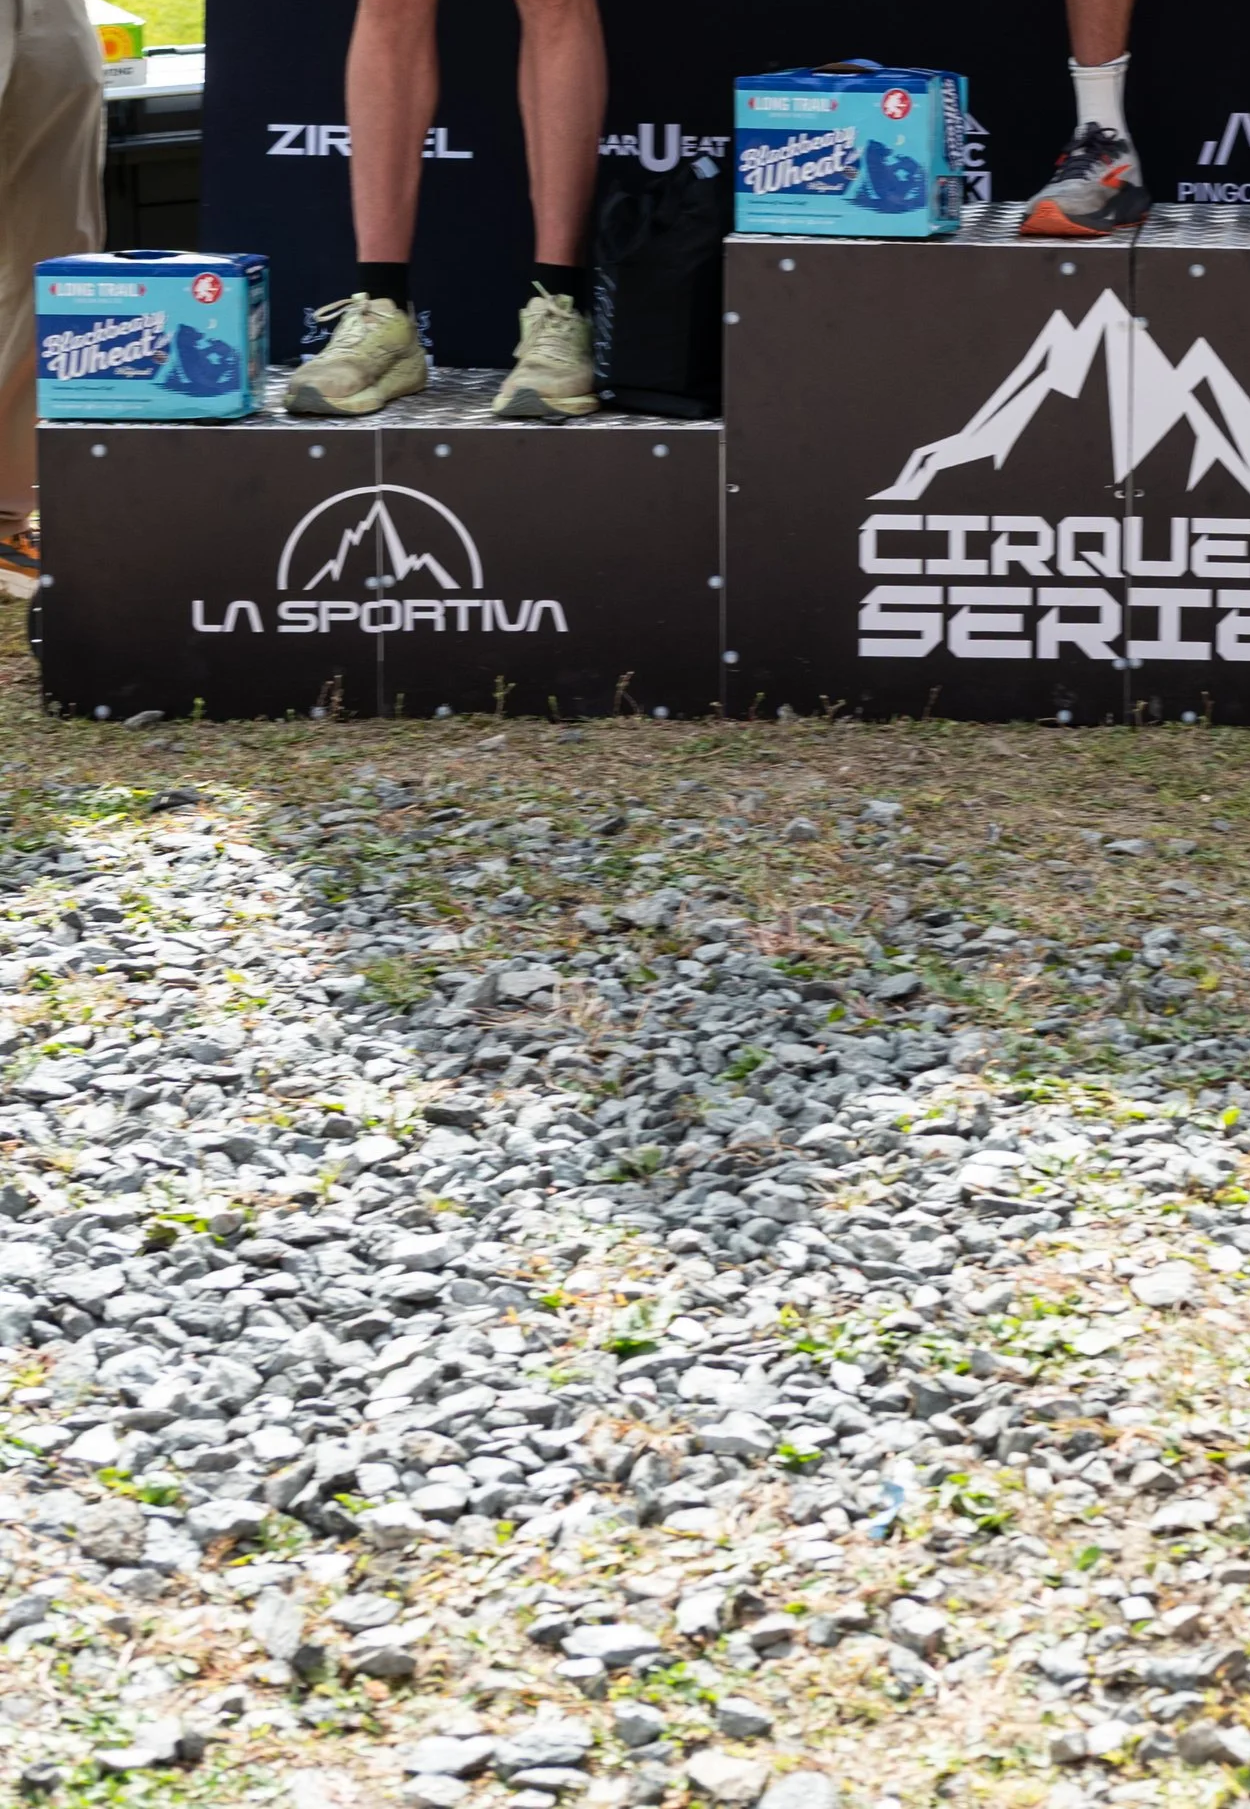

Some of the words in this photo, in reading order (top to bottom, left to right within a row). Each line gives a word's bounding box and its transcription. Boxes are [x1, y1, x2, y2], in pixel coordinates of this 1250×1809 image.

[755, 97, 790, 111] LONG
[793, 97, 832, 112] TRAIL
[744, 143, 850, 195] Wheat
[55, 283, 96, 297] LONG
[98, 283, 140, 297] TRAIL
[47, 330, 157, 381] Wheat
[192, 600, 262, 633] LA
[277, 599, 569, 633] SPORTIVA
